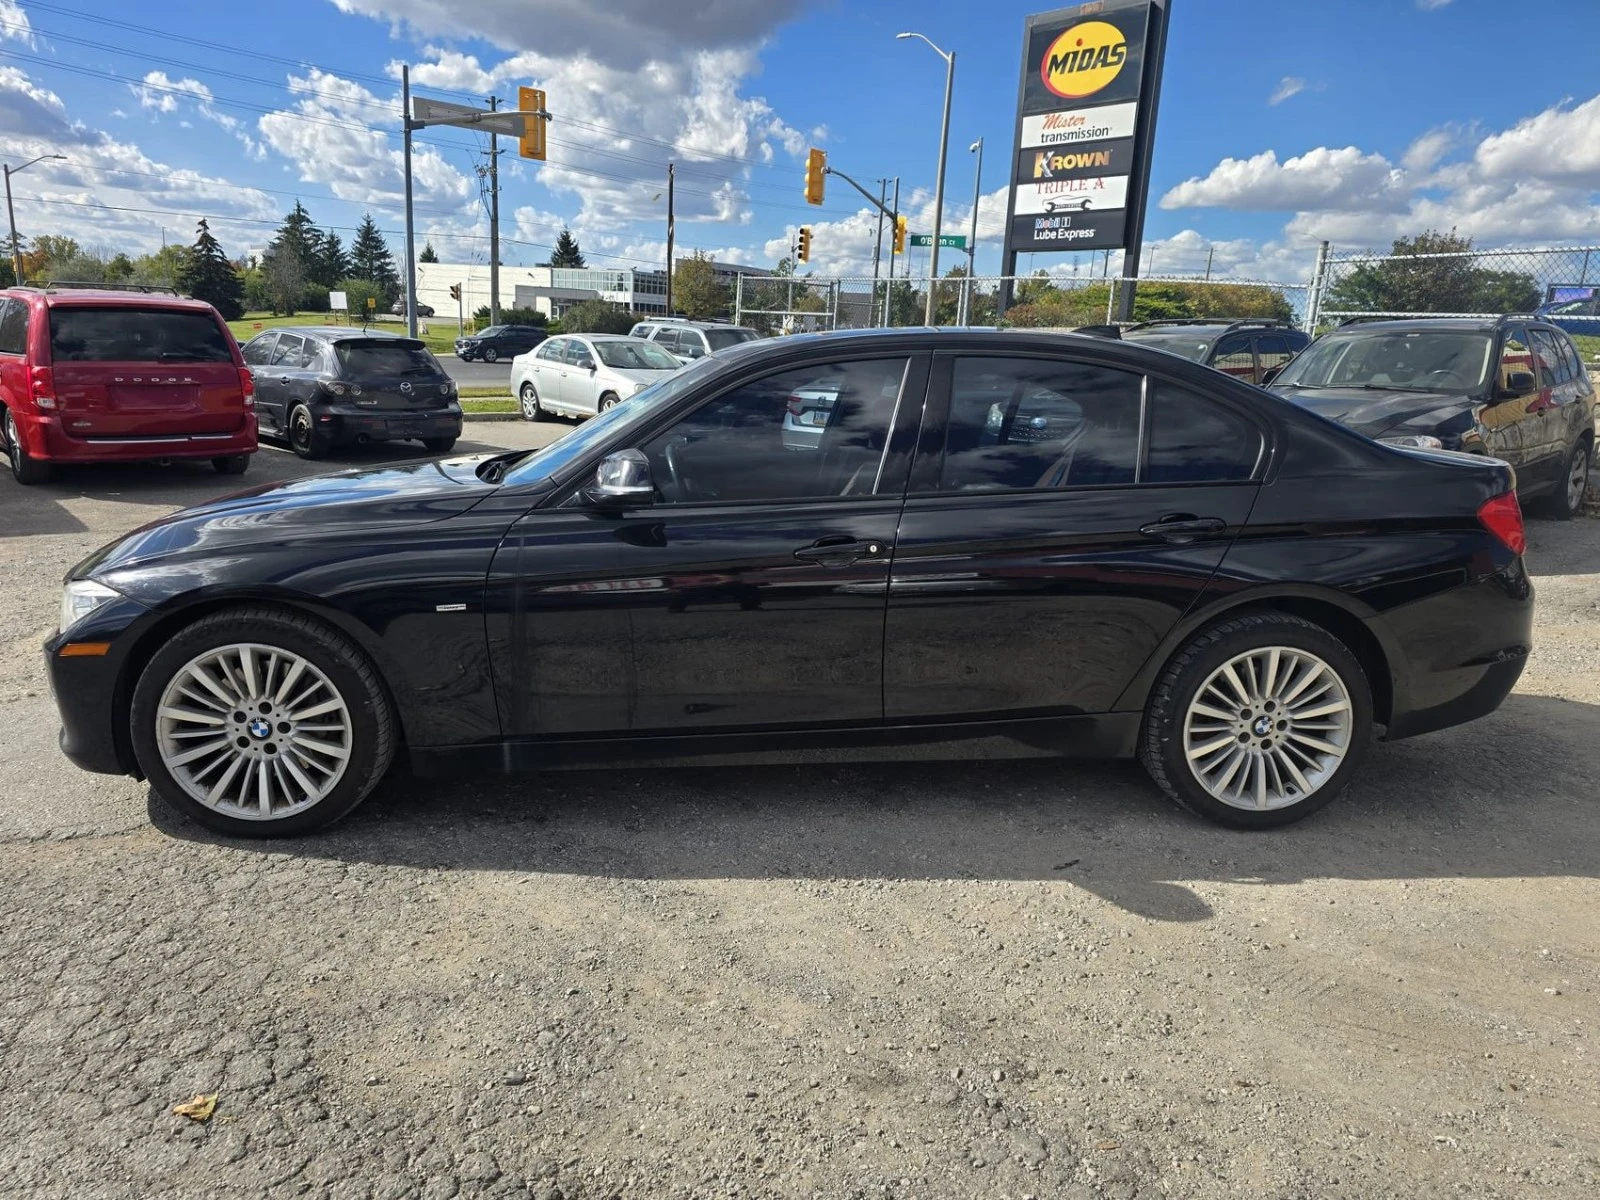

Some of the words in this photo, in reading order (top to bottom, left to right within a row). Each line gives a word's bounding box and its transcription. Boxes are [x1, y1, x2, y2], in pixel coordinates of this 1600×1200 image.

[1047, 40, 1127, 78] MIDAS
[1042, 113, 1086, 130] Mister
[1041, 126, 1109, 143] transmission
[1036, 178, 1087, 195] TRIPLE
[1093, 177, 1105, 190] A
[1035, 217, 1060, 229] Mobil
[1034, 229, 1057, 240] Lube
[1057, 228, 1095, 241] Express
